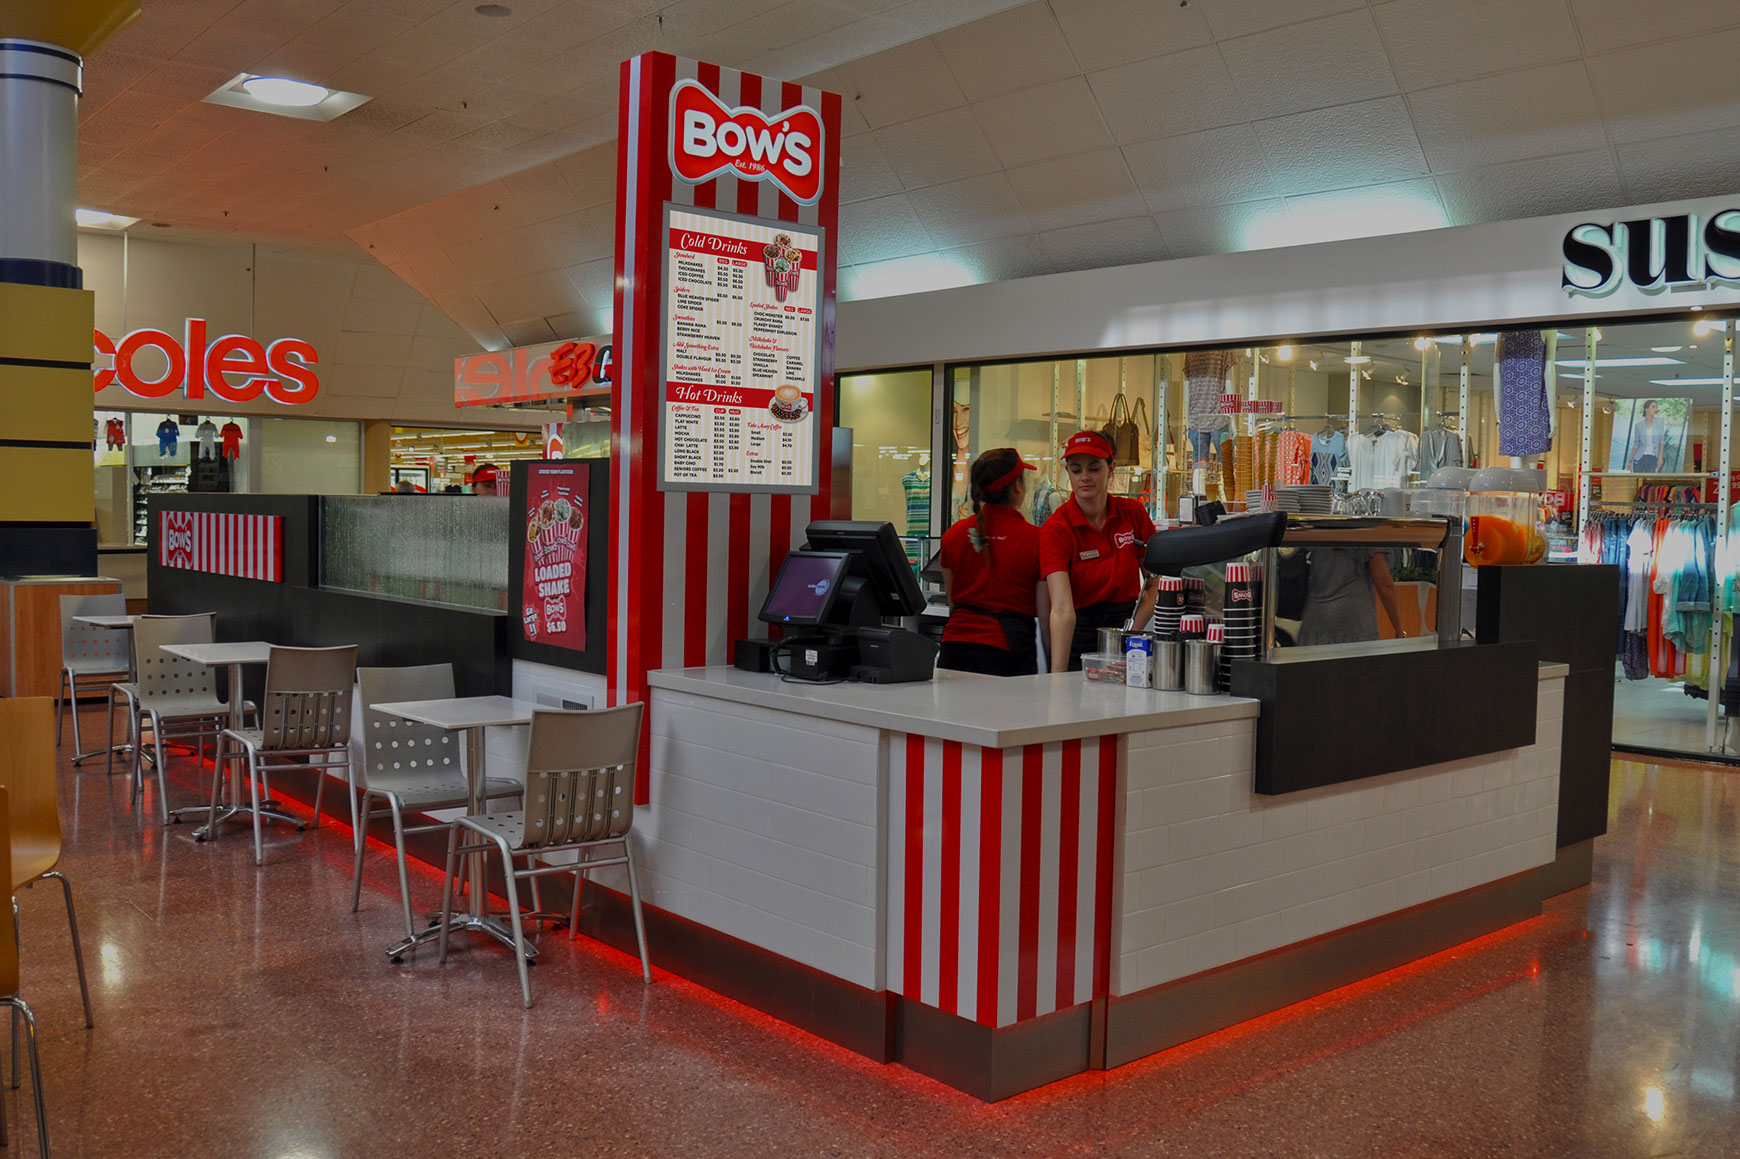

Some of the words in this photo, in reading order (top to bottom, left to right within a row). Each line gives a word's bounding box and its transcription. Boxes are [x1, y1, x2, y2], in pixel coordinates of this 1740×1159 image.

[683, 109, 812, 176] BOW'S
[735, 159, 746, 169] Est.
[749, 162, 765, 171] 1986
[681, 233, 706, 249] Cold
[708, 237, 747, 254] Drinks
[676, 385, 701, 400] Hot
[703, 389, 743, 403] Drinks
[169, 526, 191, 552] BOW'S
[534, 562, 572, 582] LOADED
[538, 579, 570, 597] SHAKE
[546, 621, 566, 634] $6.50
